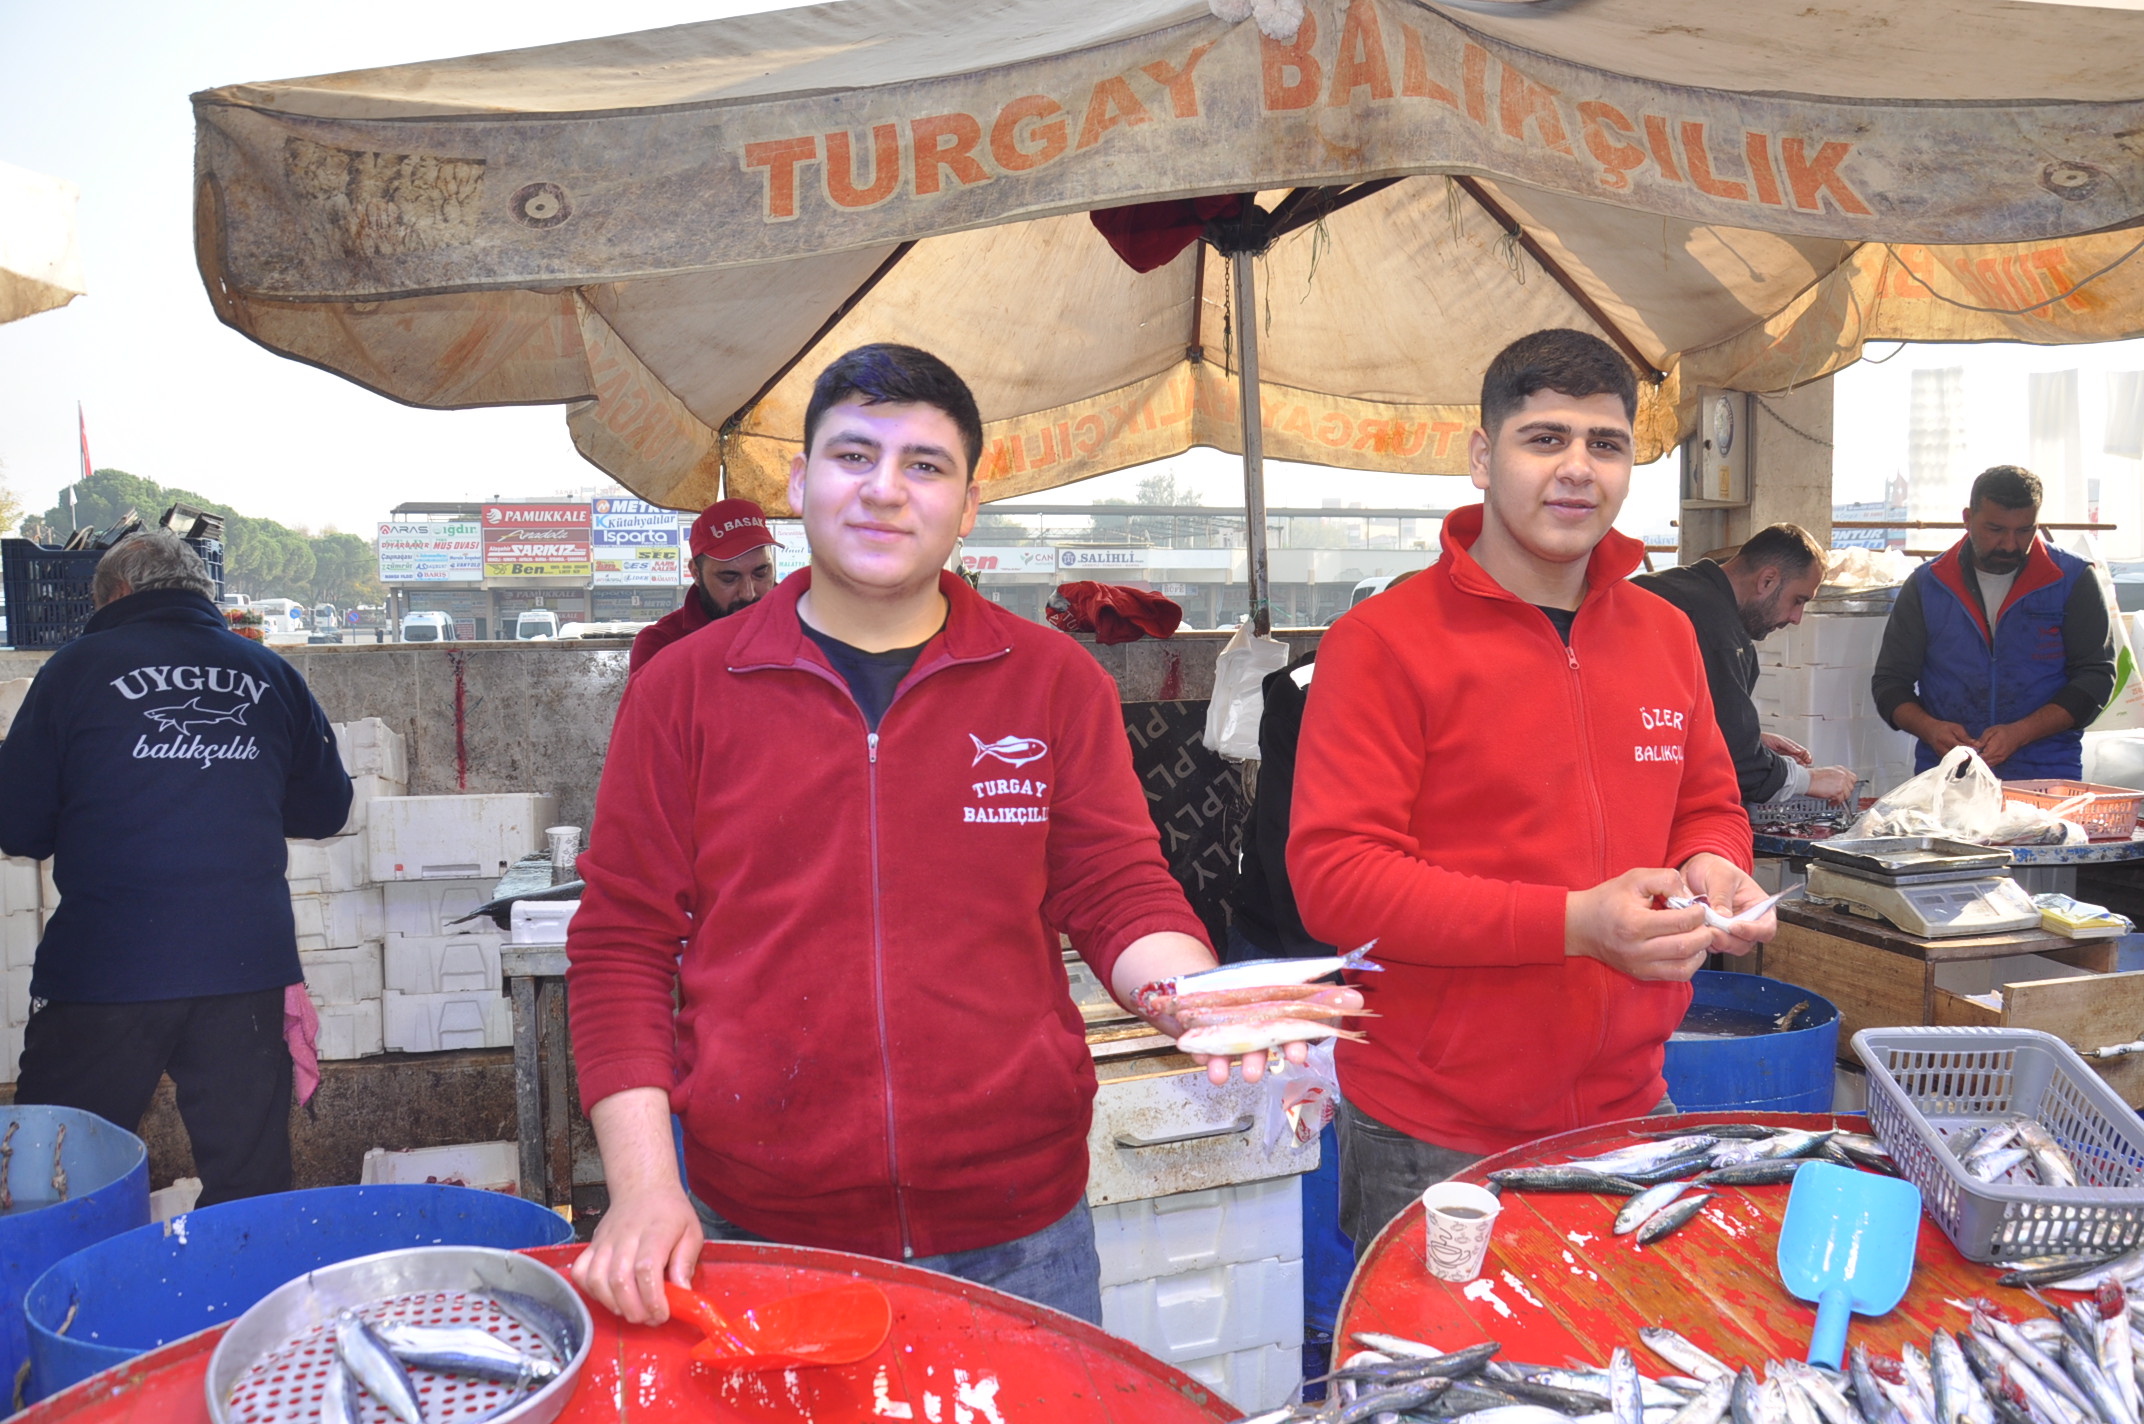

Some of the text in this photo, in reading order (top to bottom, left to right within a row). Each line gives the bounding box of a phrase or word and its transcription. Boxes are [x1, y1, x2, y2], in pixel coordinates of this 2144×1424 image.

[744, 0, 1874, 217] TURGAY BALIKÇILIK
[611, 500, 672, 513] METR
[504, 510, 587, 522] PAMUKKALE
[390, 526, 428, 534] ARAS
[1035, 553, 1054, 562] CAN
[1080, 550, 1135, 563] SALİHLİ
[512, 563, 545, 574] Ben
[110, 666, 270, 704] UYGUN
[1639, 706, 1684, 730] ÖZER
[132, 734, 260, 770] balıkçılık
[972, 778, 1048, 798] TURGAY
[963, 806, 1049, 826] BALIKÇILI
